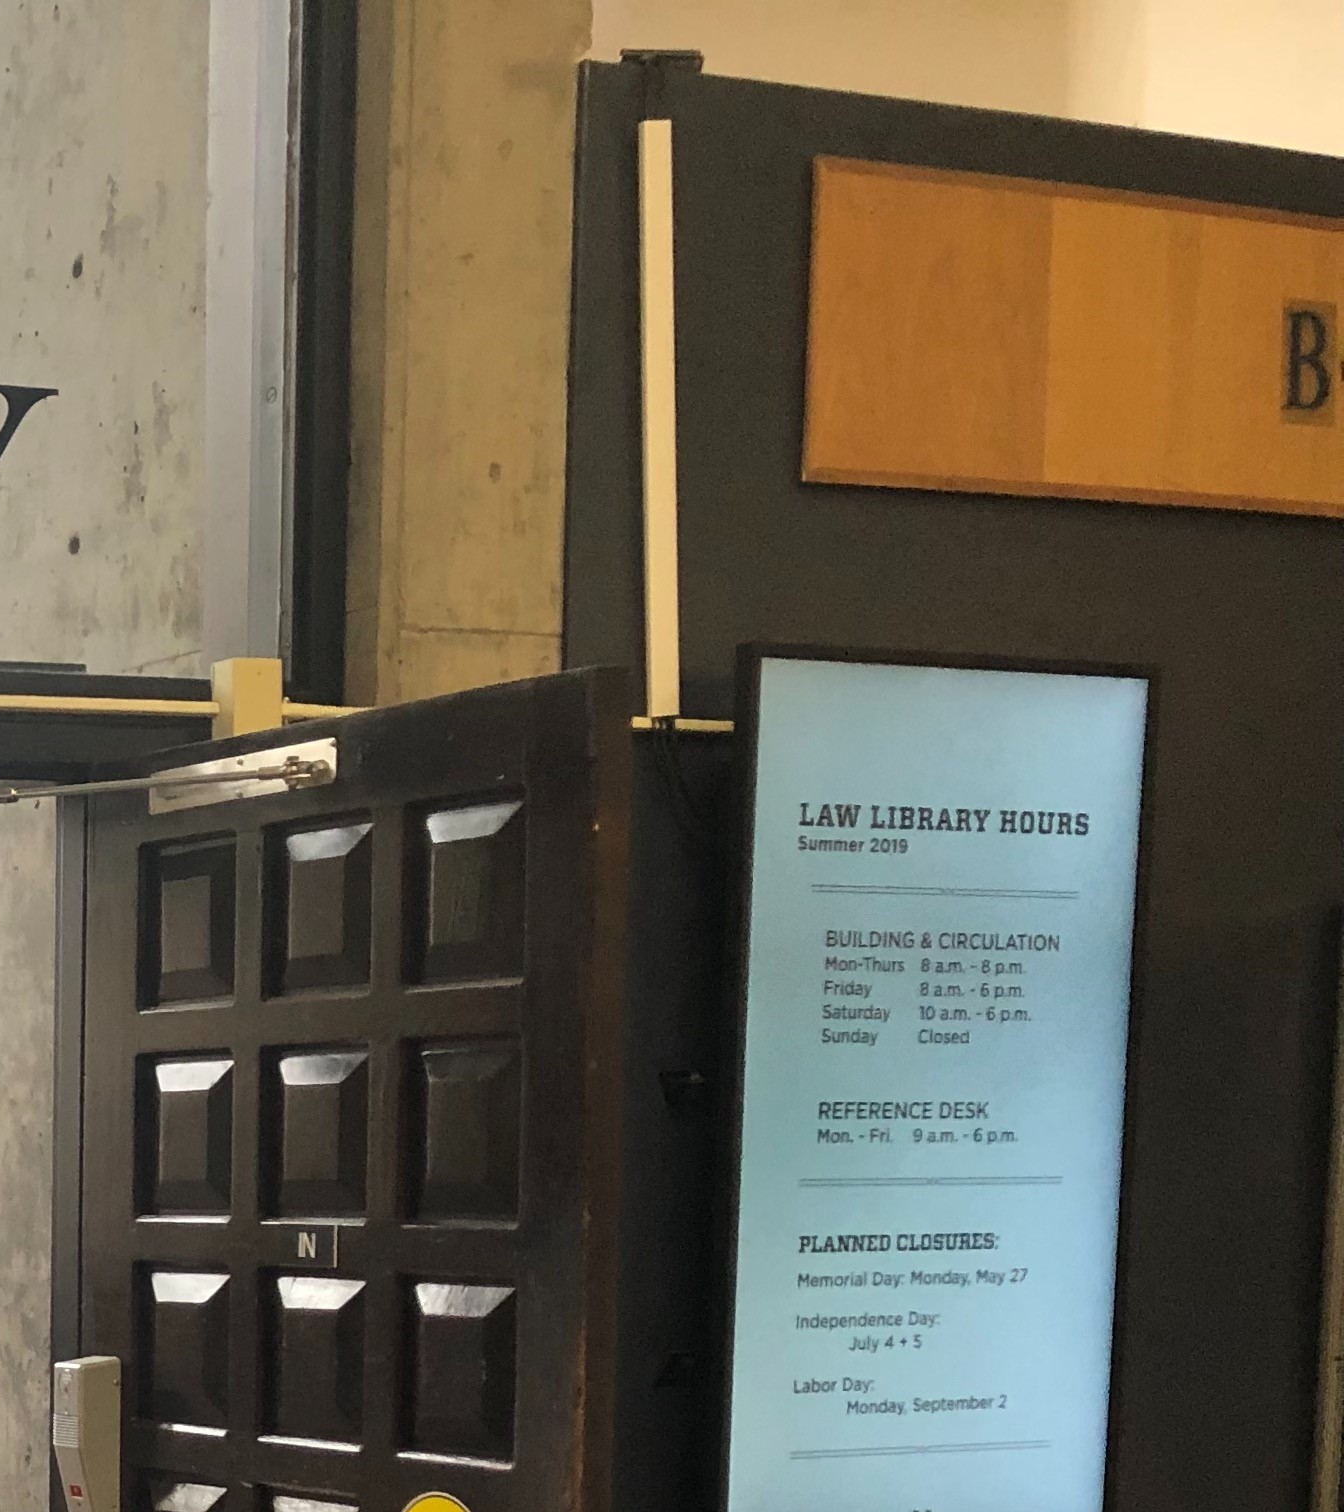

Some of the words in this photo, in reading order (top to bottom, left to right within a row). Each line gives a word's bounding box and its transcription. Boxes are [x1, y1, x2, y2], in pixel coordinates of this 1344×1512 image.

[1281, 310, 1344, 412] B
[799, 803, 861, 828] LAW
[870, 805, 990, 832] LIBRARY
[1000, 810, 1090, 836] HOURS
[798, 835, 864, 852] Summer
[870, 838, 909, 854] 2019
[826, 930, 915, 949] BUILDING
[921, 931, 932, 949] &
[939, 932, 1060, 951] CIRCULATION
[826, 957, 904, 973] Mon-Thurs
[920, 958, 930, 972] 8
[981, 960, 991, 973] 8
[824, 981, 872, 999] Friday
[920, 982, 929, 996] 8
[822, 1004, 890, 1022] Saturday
[919, 1006, 935, 1020] 10
[986, 1007, 996, 1021] 6
[822, 1029, 878, 1046] Sunday
[918, 1030, 970, 1044] Closed
[818, 1101, 933, 1119] REFERENCE
[939, 1101, 990, 1119] DESK
[817, 1129, 853, 1143] Mon.
[913, 1128, 922, 1143] 9
[973, 1129, 982, 1142] 6
[297, 1231, 317, 1259] IN
[799, 1234, 890, 1253] PLANNED
[896, 1233, 1000, 1251] CLOSURES:
[797, 1271, 867, 1287] Memorial
[872, 1272, 904, 1288] Day:
[910, 1270, 971, 1287] Monday,
[976, 1269, 1006, 1286] May
[1009, 1268, 1028, 1282] 27
[796, 1313, 903, 1330] Independence
[908, 1311, 940, 1328] Day:
[849, 1336, 879, 1353] July
[884, 1336, 895, 1349] 4
[899, 1338, 907, 1346] +
[913, 1335, 922, 1348] 5
[793, 1379, 837, 1394] Labor
[842, 1377, 874, 1393] Day:
[847, 1400, 907, 1415] Monday,
[913, 1396, 994, 1413] September
[998, 1395, 1007, 1408] 2
